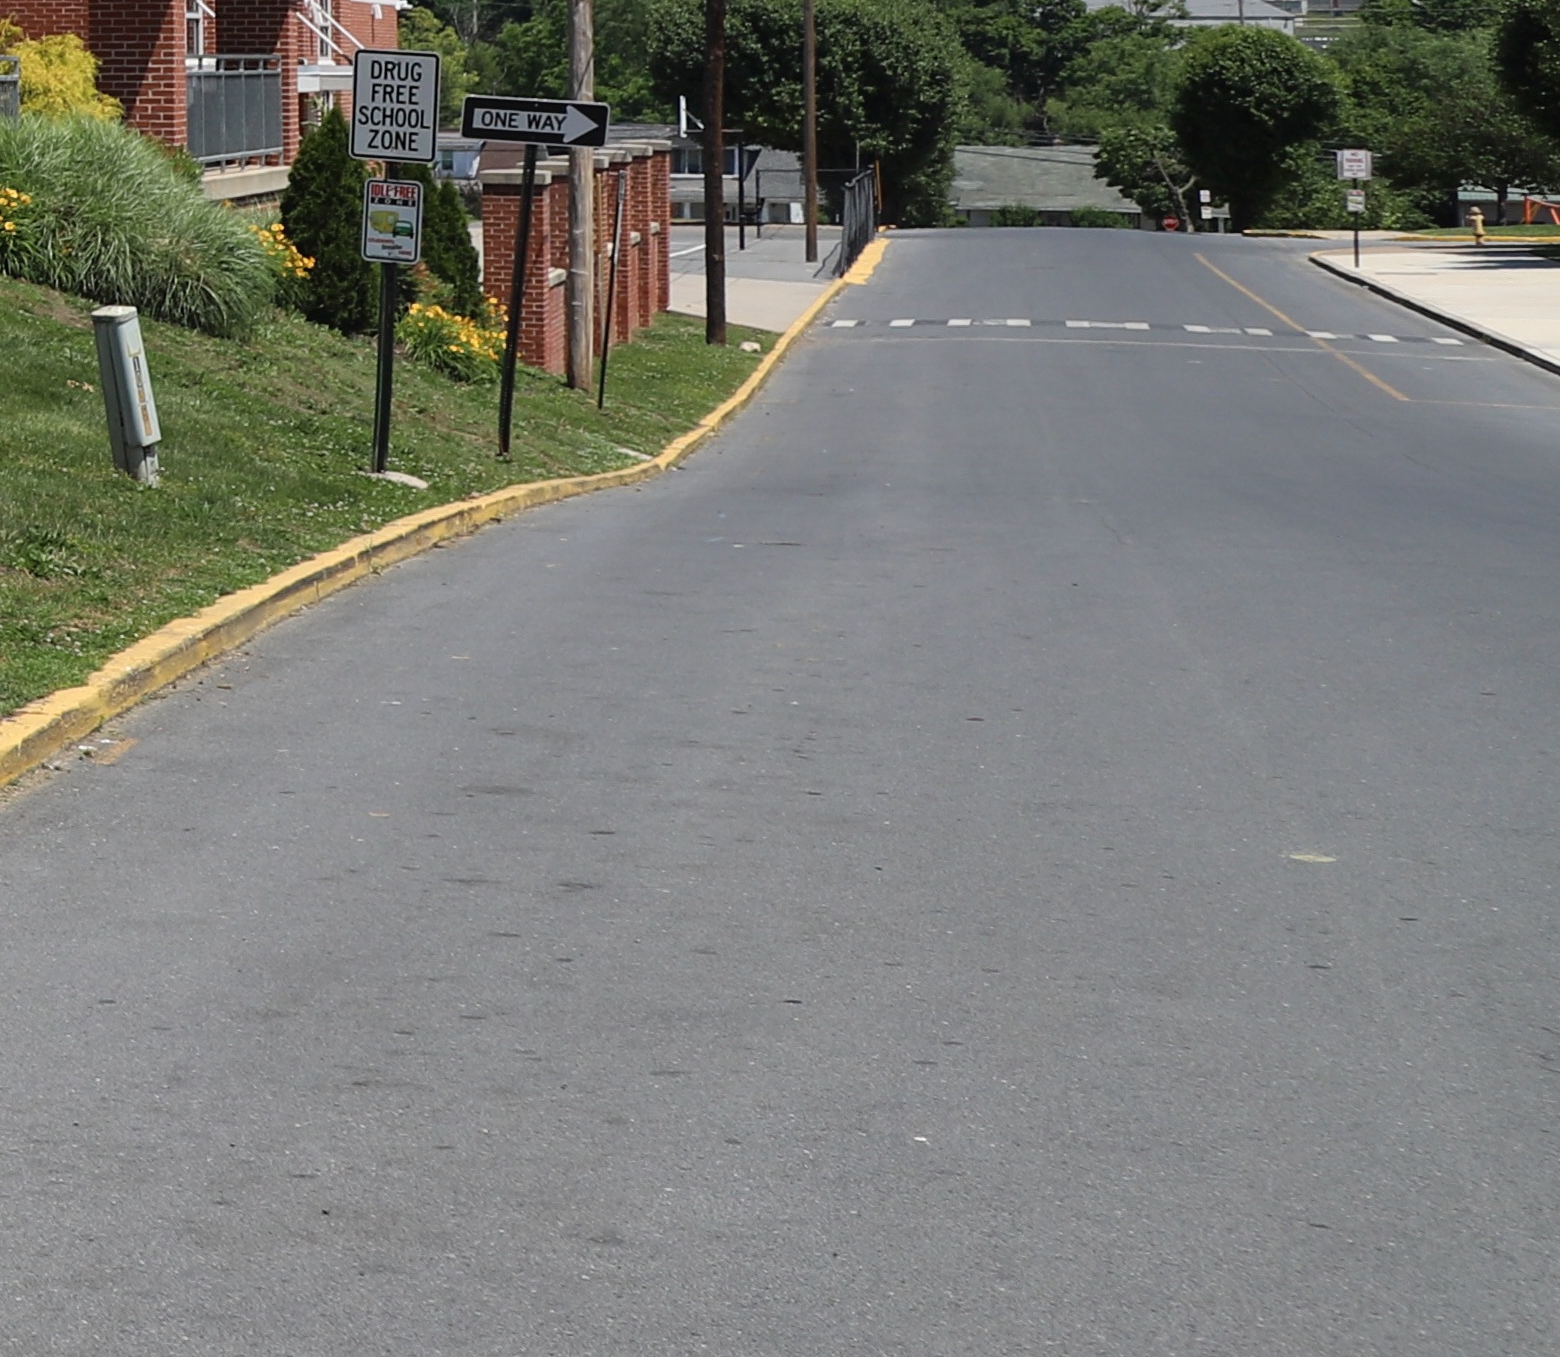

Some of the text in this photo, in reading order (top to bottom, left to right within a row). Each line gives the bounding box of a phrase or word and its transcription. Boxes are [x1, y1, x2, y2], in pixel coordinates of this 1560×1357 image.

[371, 60, 422, 82] DRUG
[371, 83, 420, 105] FREE
[358, 105, 431, 129] SCHOOL
[481, 111, 567, 131] ONE WAY
[368, 129, 419, 152] ZONE
[371, 184, 417, 199] IDLE FREE
